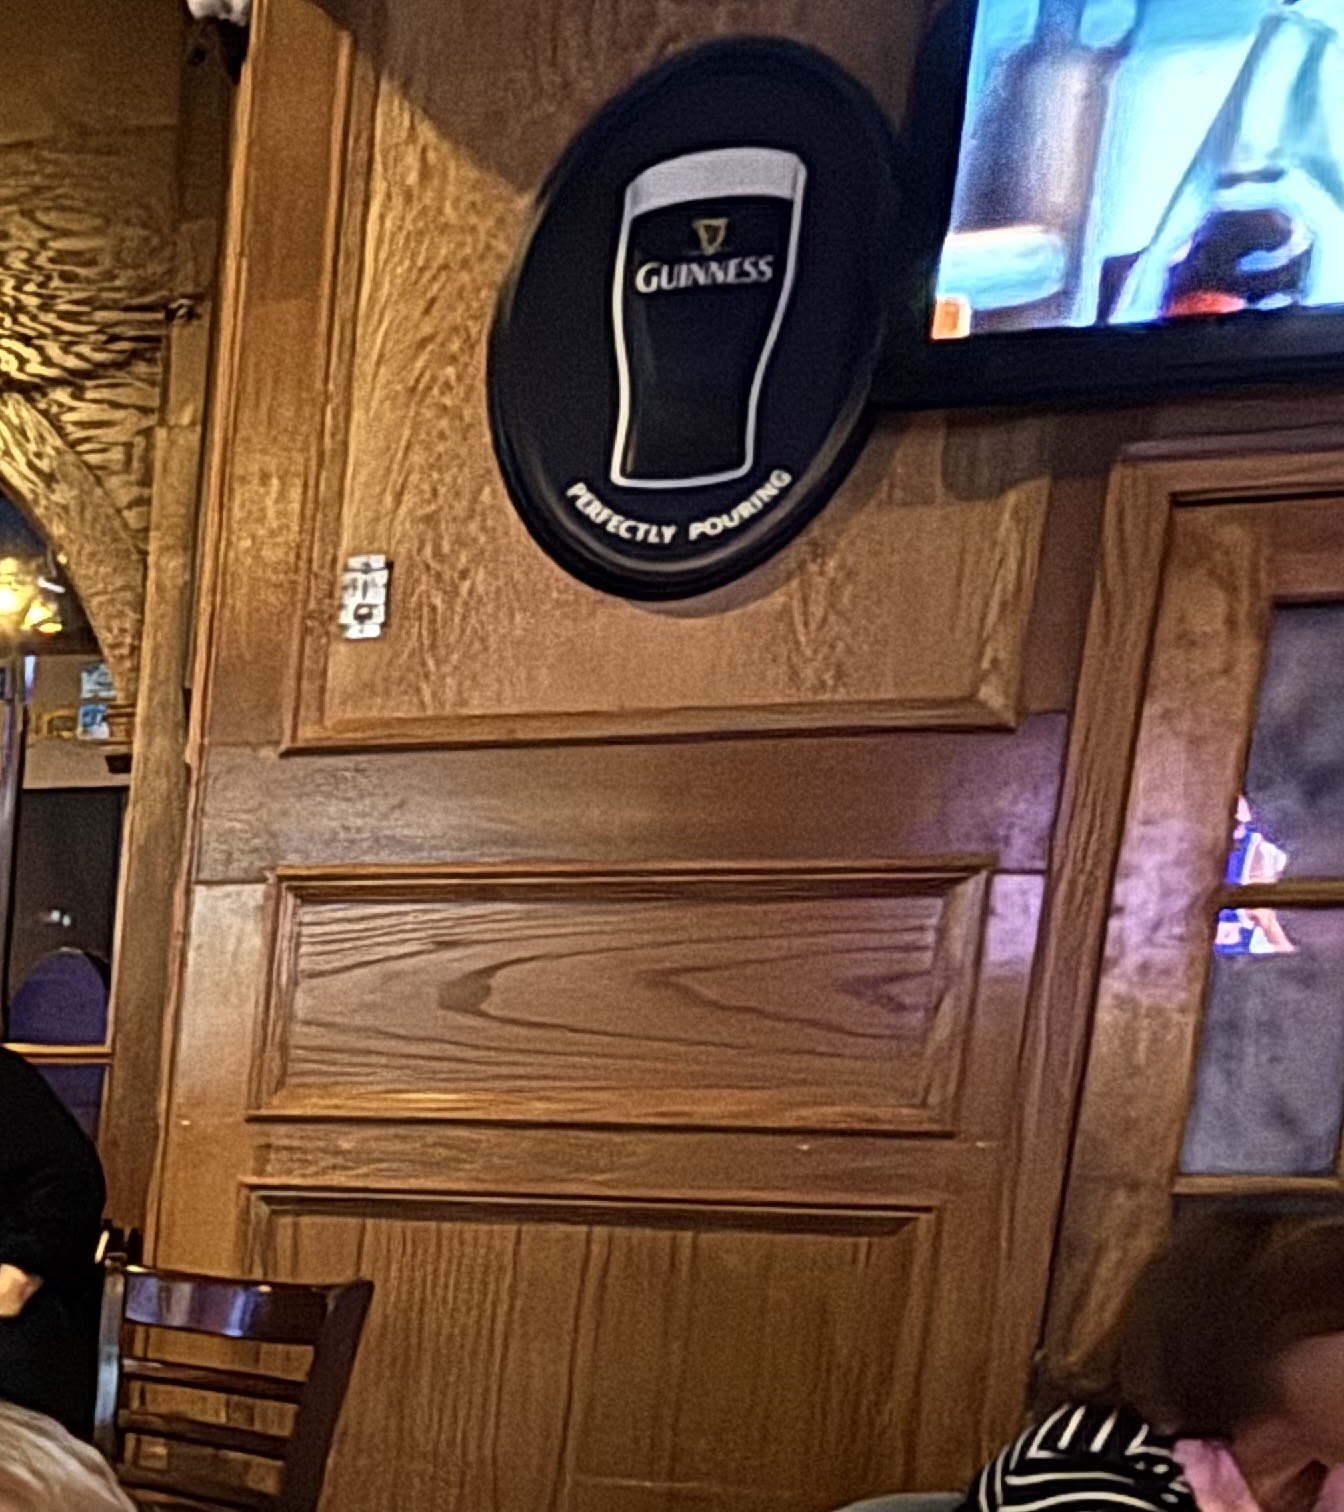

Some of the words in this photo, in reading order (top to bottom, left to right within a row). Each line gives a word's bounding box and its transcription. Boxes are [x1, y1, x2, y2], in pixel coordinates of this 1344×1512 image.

[635, 254, 774, 293] GUINNESS
[566, 482, 677, 543] PERFECTLY
[688, 469, 792, 541] POURING
